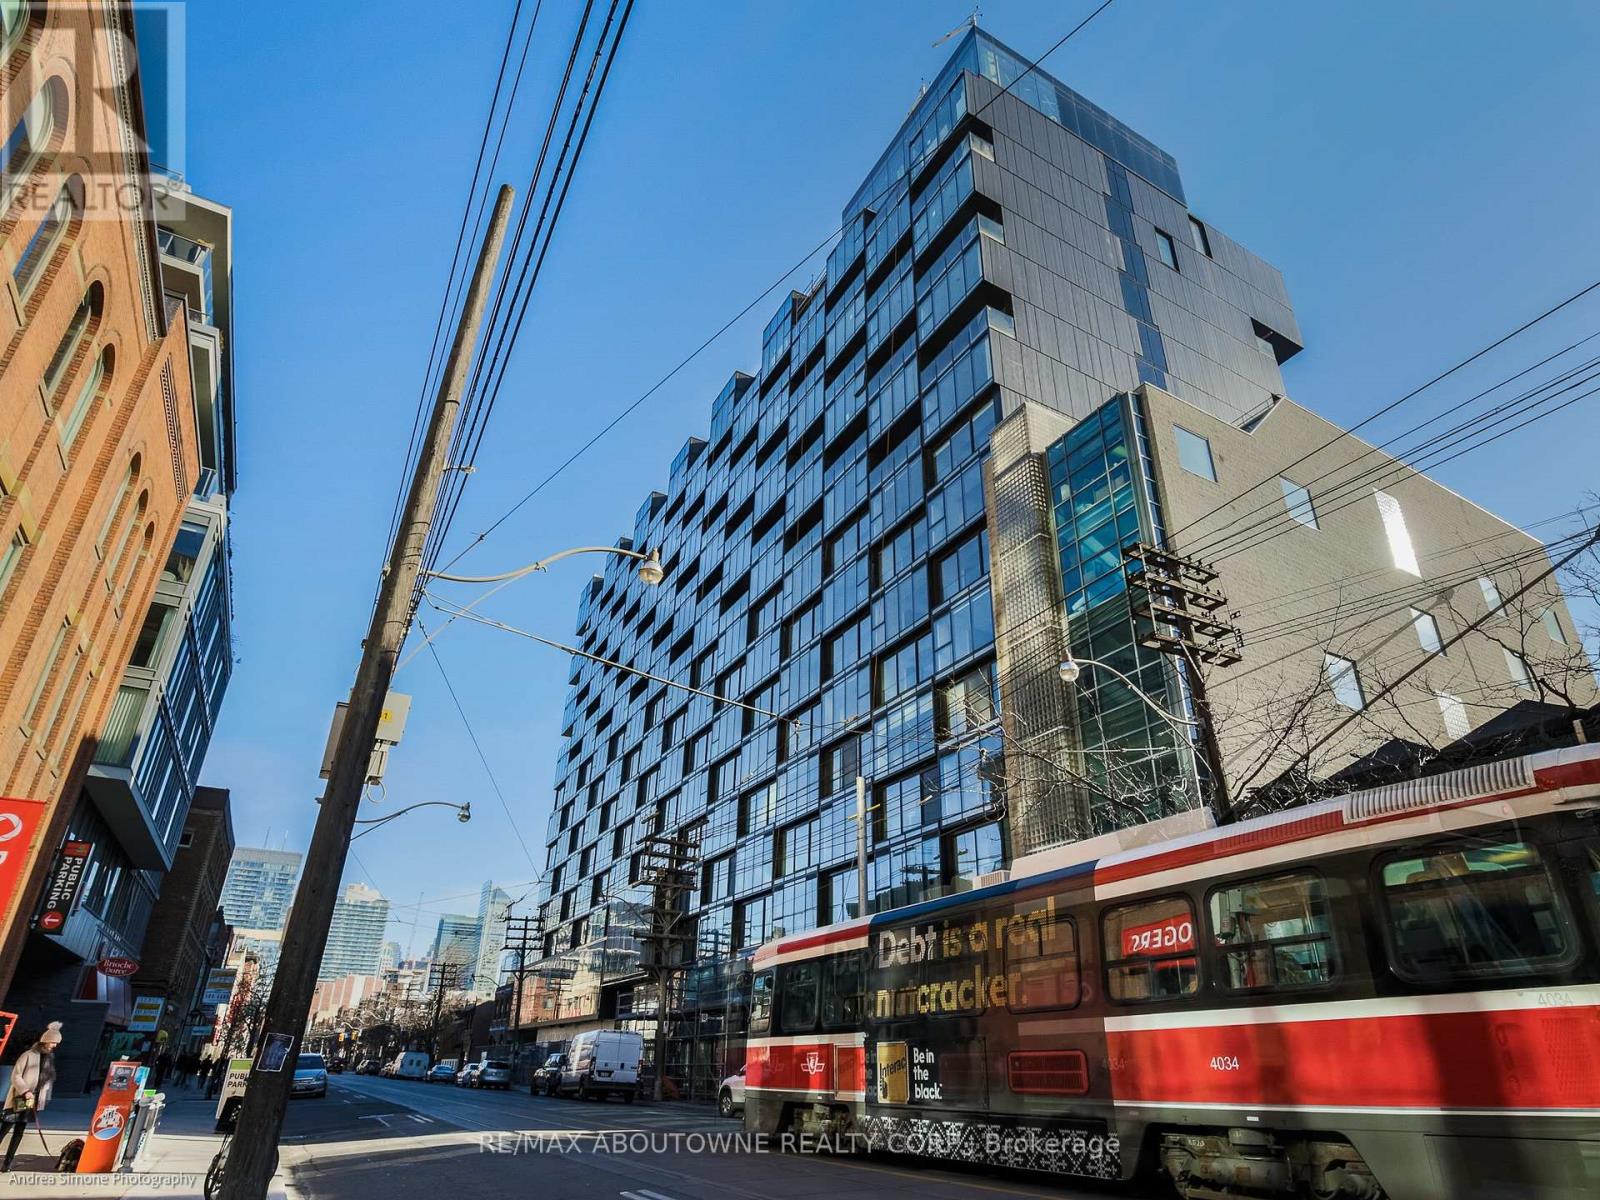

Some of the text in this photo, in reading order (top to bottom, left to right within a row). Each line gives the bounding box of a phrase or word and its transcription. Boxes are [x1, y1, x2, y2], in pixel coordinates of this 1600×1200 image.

[47, 856, 73, 910] PARKING
[61, 857, 83, 900] PUBLIC
[878, 925, 937, 968] Debt
[942, 919, 962, 957] is
[968, 921, 988, 952] a
[913, 1047, 935, 1063] Be in
[1209, 1056, 1240, 1071] 4034
[913, 1065, 929, 1081] the
